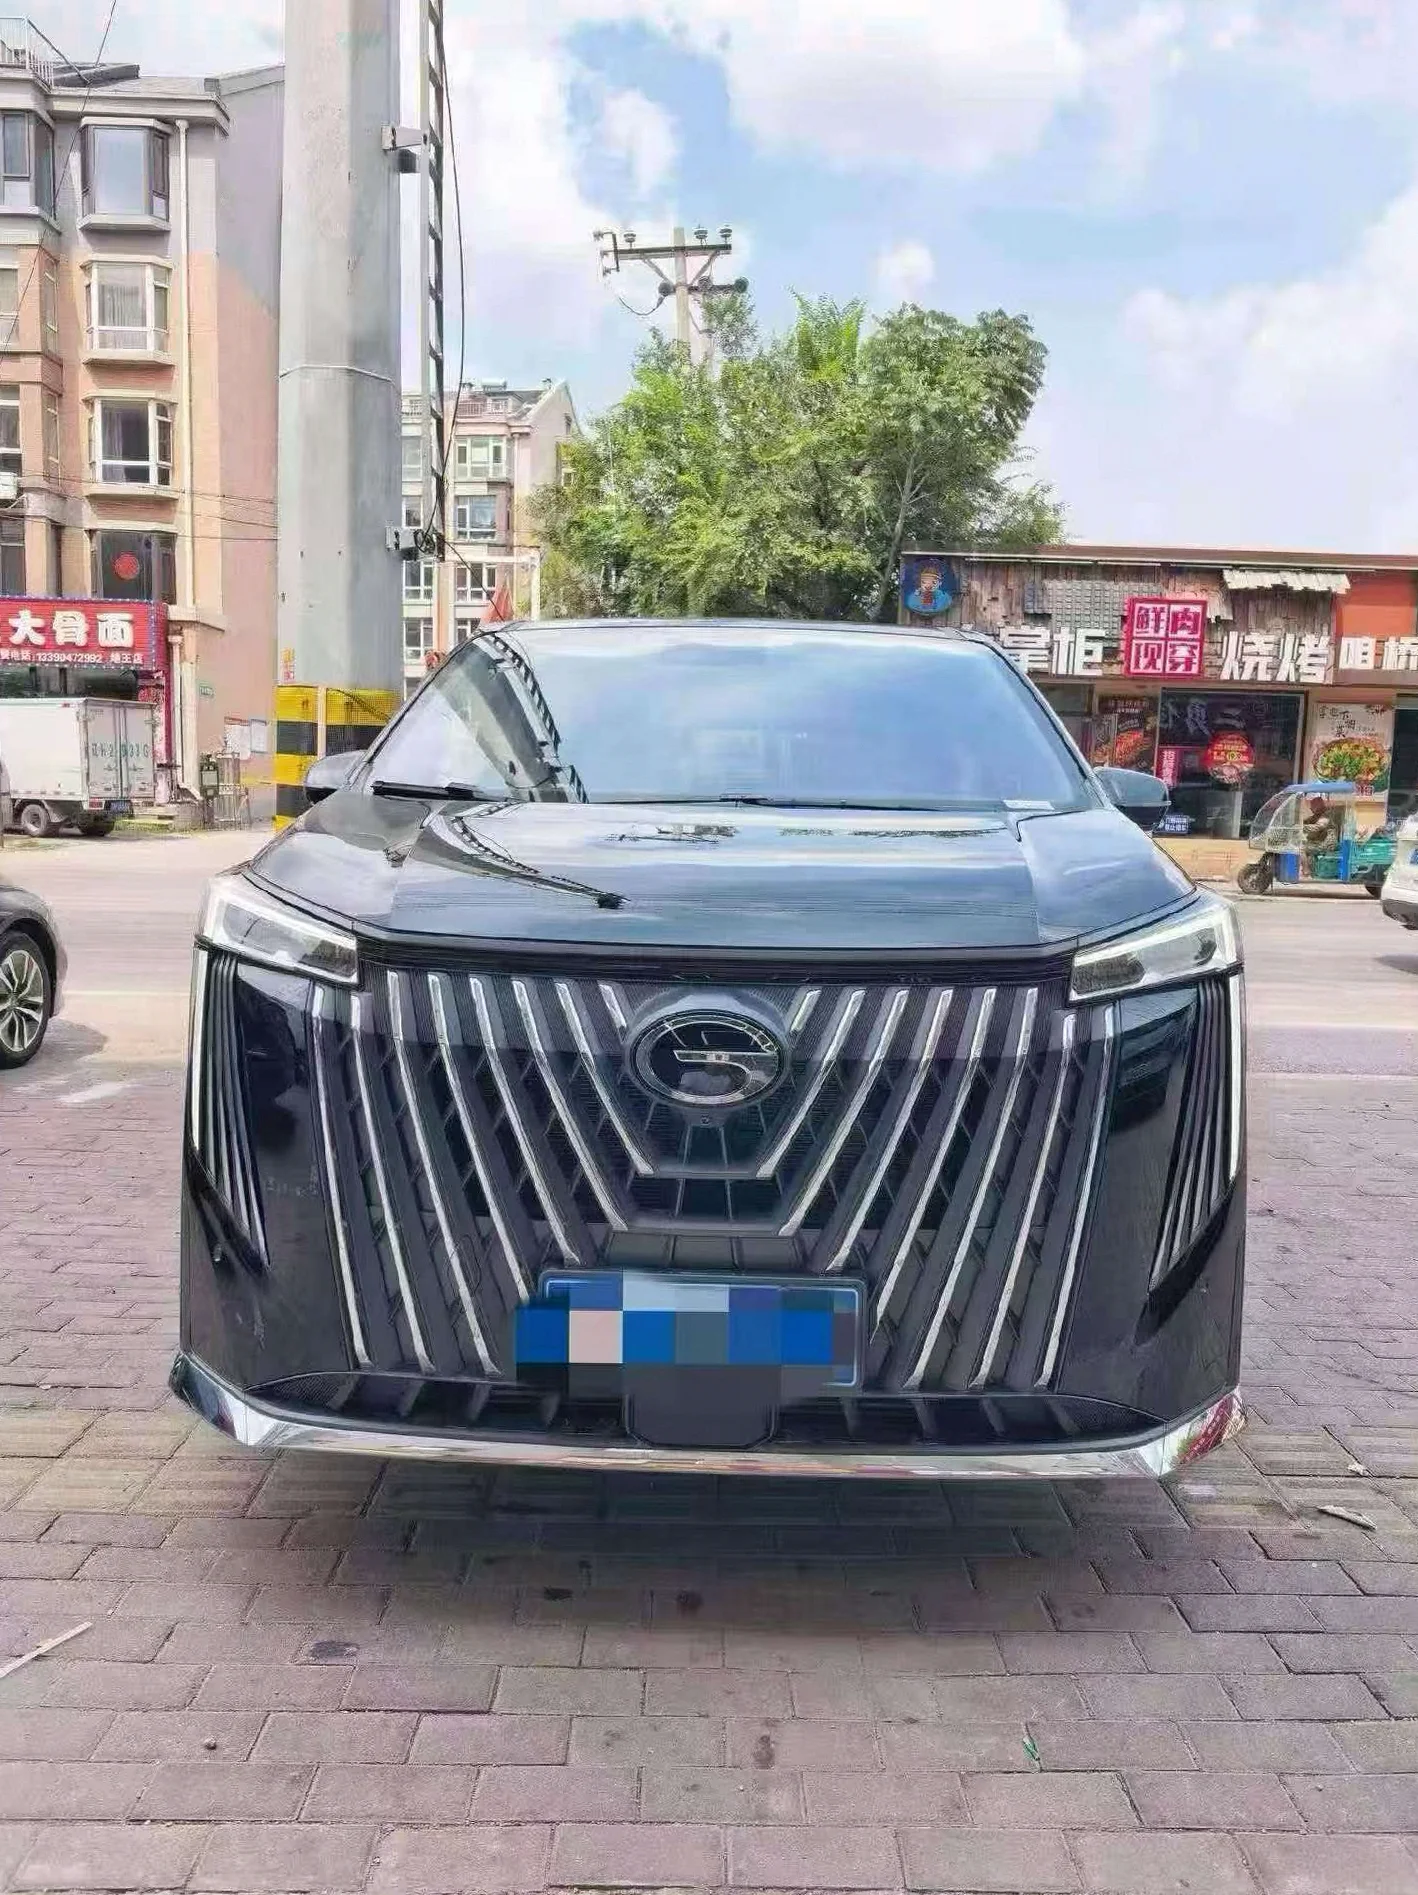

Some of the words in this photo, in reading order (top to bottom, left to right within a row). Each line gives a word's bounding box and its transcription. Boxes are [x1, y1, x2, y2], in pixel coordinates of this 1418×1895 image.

[8, 609, 134, 648] 大骨面
[1136, 606, 1200, 637] 鲜肉
[1000, 623, 1105, 675] 掌柜
[1133, 642, 1199, 672] 现穿
[1220, 631, 1331, 684] 烧烤
